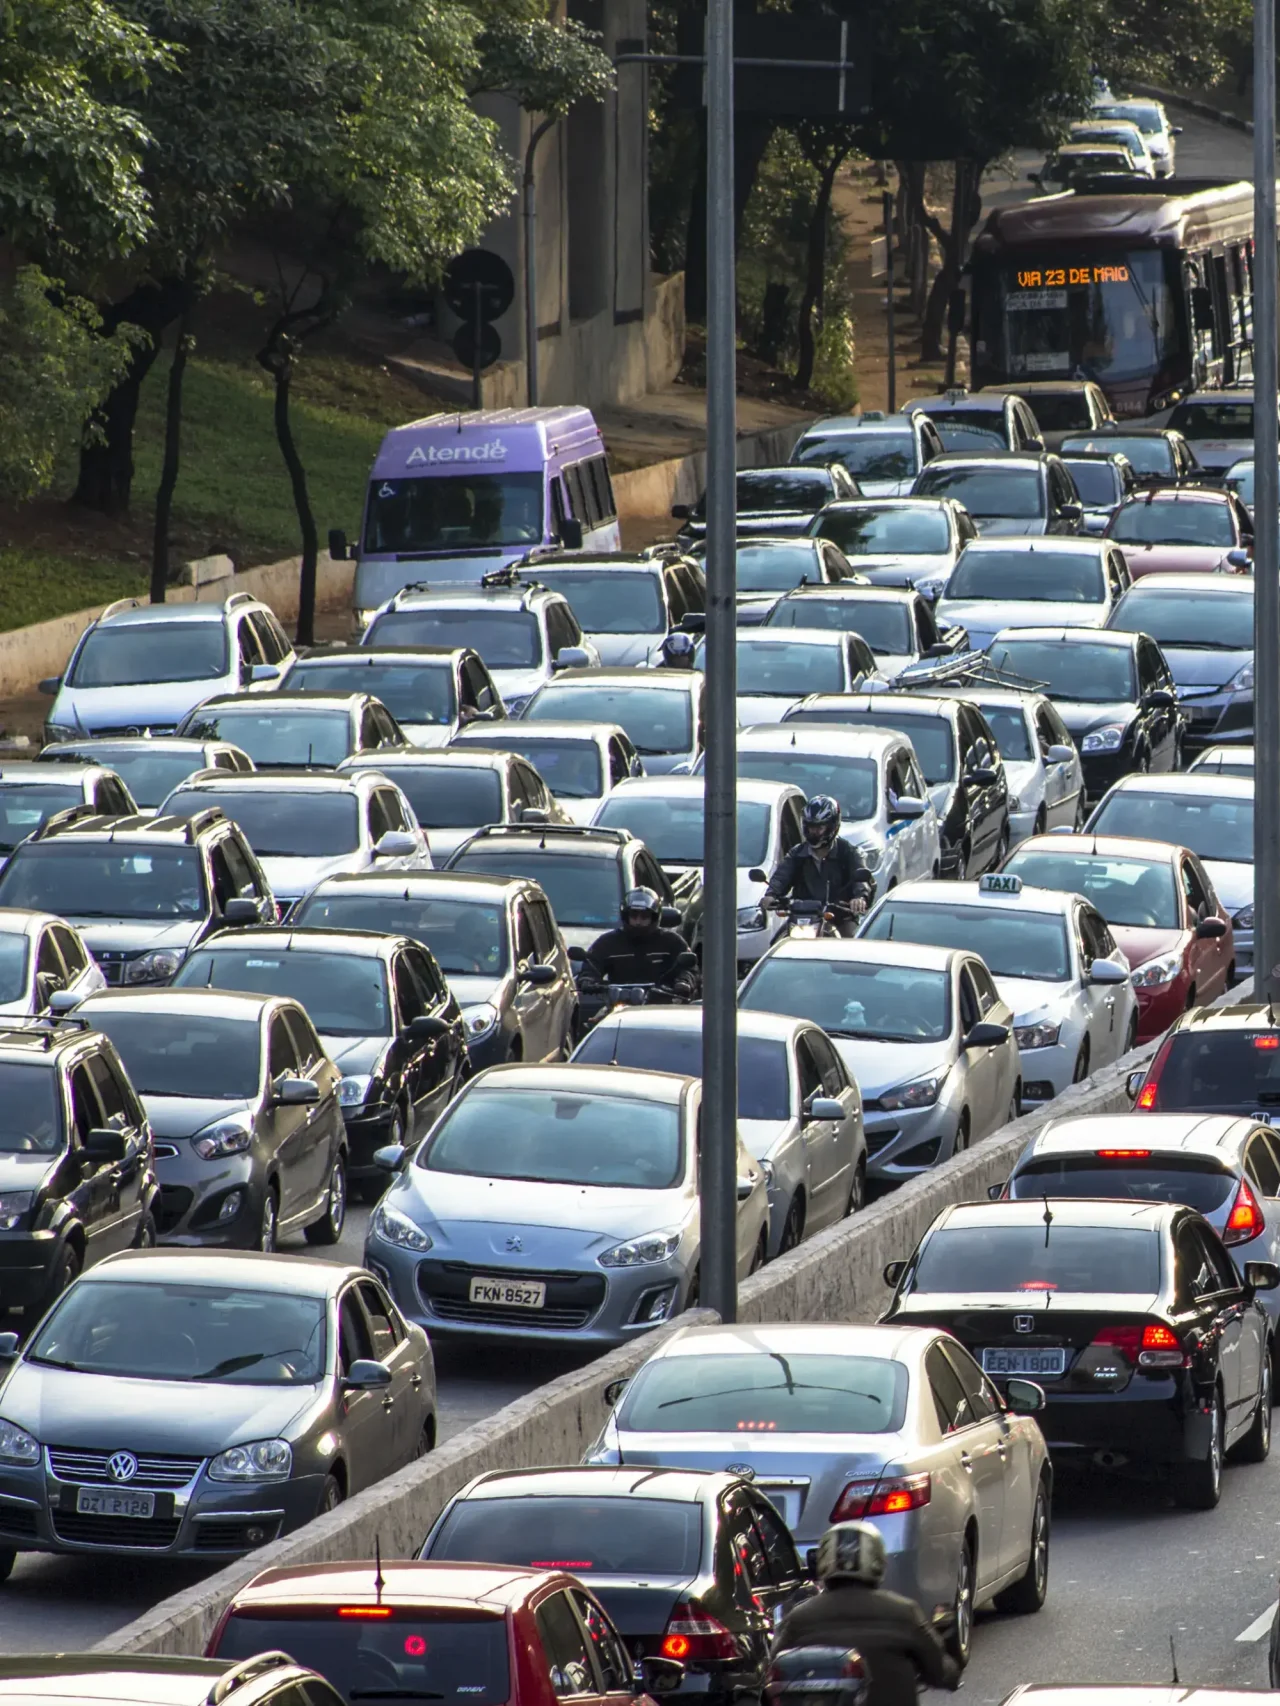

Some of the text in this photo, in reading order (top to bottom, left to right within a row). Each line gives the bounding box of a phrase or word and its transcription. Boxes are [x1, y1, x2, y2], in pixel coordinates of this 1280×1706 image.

[1018, 266, 1129, 287] VIA 23 DE MAIO
[986, 876, 1017, 890] TAXI
